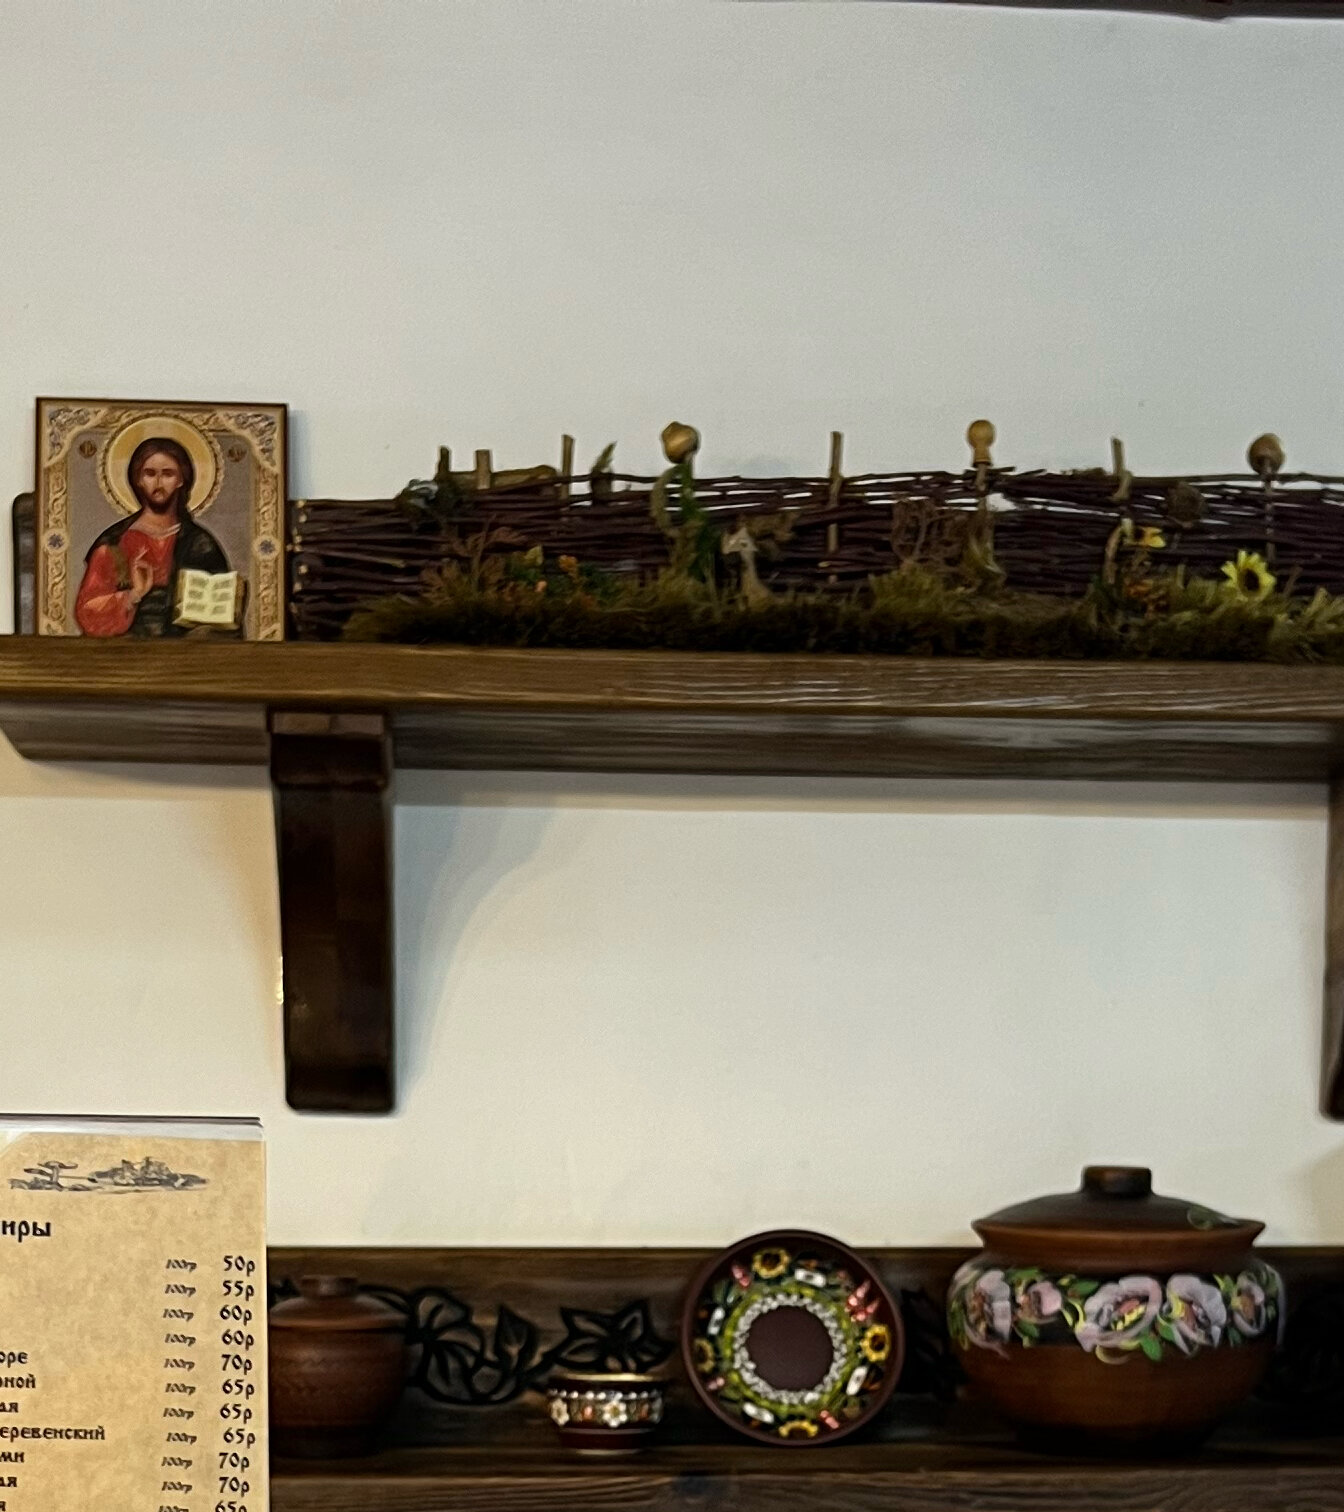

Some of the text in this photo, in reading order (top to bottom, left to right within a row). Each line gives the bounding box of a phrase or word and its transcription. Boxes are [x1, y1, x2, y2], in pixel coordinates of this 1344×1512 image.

[223, 1255, 256, 1278] 50р
[222, 1279, 255, 1302] 55р
[219, 1304, 253, 1327] 60р
[221, 1328, 255, 1352] 60р
[221, 1353, 253, 1376] 70р
[221, 1378, 255, 1400] 65р
[219, 1402, 253, 1425] 65р
[222, 1427, 256, 1450] 65р
[218, 1451, 250, 1473] 70р
[218, 1476, 250, 1498] 70р
